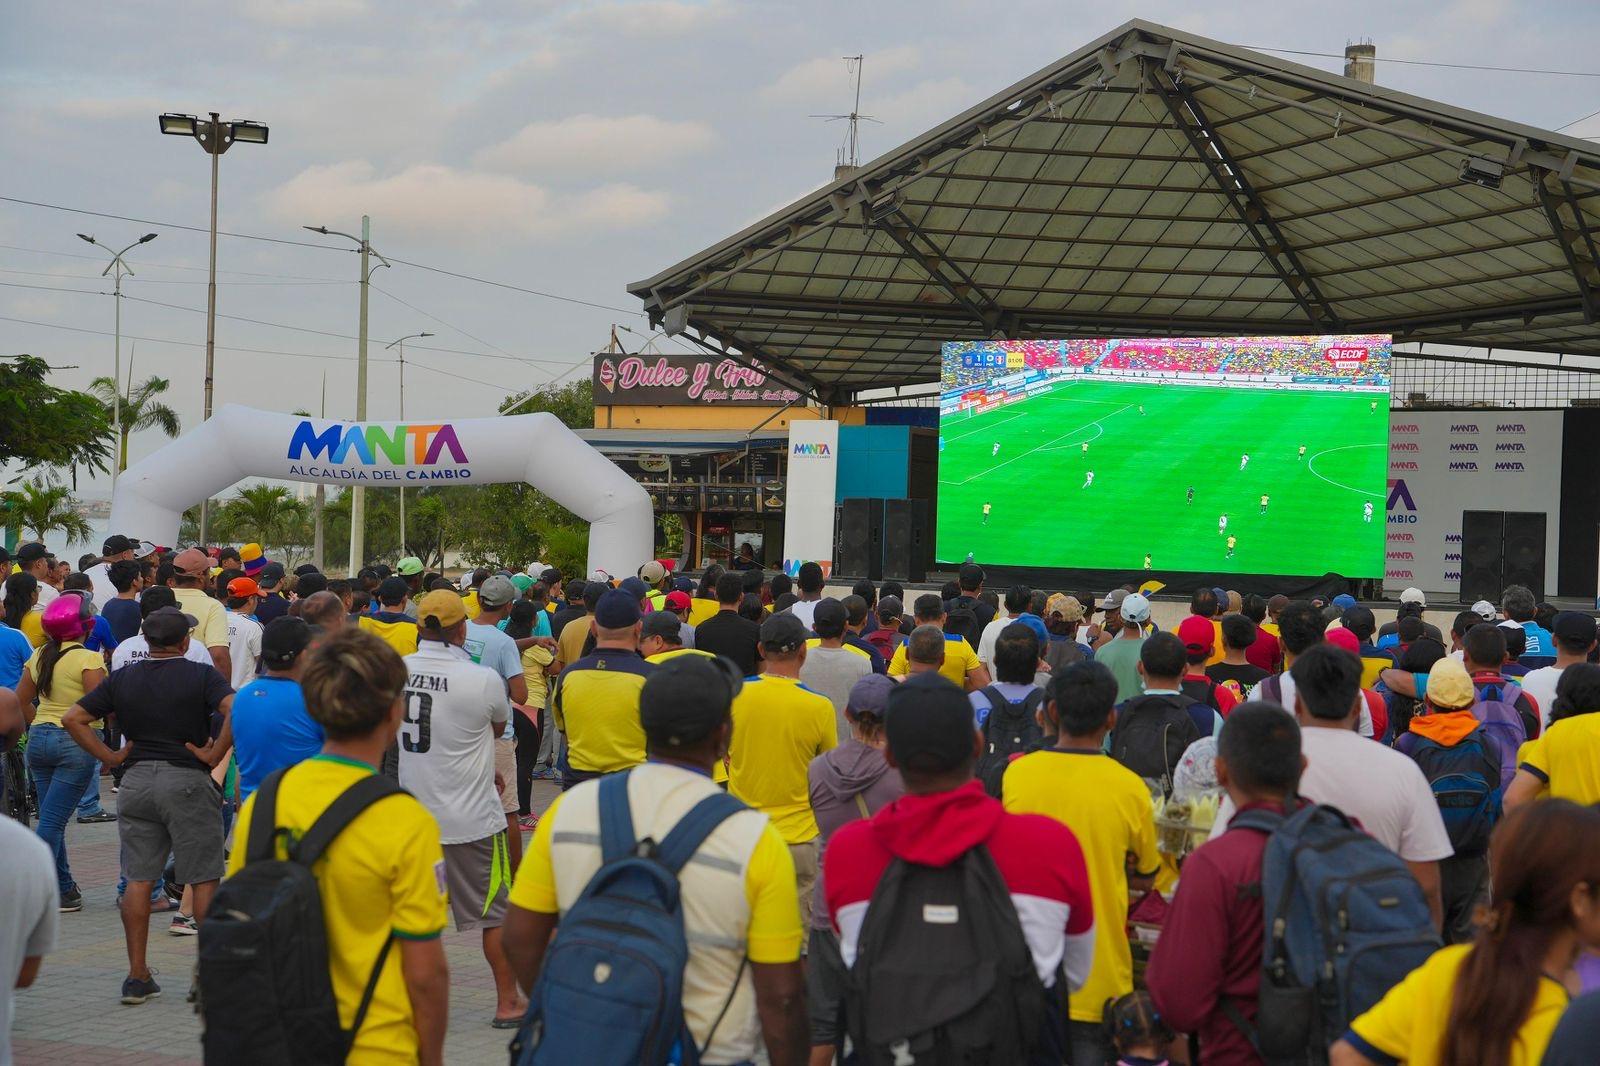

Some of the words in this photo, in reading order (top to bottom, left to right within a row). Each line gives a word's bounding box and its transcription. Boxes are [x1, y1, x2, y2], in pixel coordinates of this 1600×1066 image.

[1340, 350, 1365, 359] ECDF
[618, 357, 688, 389] Dulce
[687, 362, 711, 399] y
[1391, 424, 1420, 432] MANTA
[1450, 424, 1479, 432] MANTA
[1496, 424, 1526, 432] MANTA
[287, 421, 469, 465] MANTA
[1391, 443, 1419, 451] MANTA
[1449, 443, 1478, 451] MANTA
[1495, 443, 1525, 451] MANTA
[793, 443, 831, 454] MANTA
[1390, 461, 1418, 469] MANTA
[1449, 461, 1478, 470] MANTA
[1495, 461, 1525, 470] MANTA
[289, 465, 368, 480] ALCALDÍA
[372, 470, 401, 480] DEL
[406, 469, 471, 479] CAMBIO
[1387, 515, 1418, 524] MBIO
[1386, 532, 1415, 541] MANTA
[1445, 534, 1463, 542] MAN
[1386, 551, 1414, 559] MANTA
[1444, 553, 1462, 561] MAN
[1385, 570, 1414, 578] MANTA
[1444, 571, 1462, 580] MAN
[131, 650, 151, 659] BAN
[402, 690, 433, 754] 9
